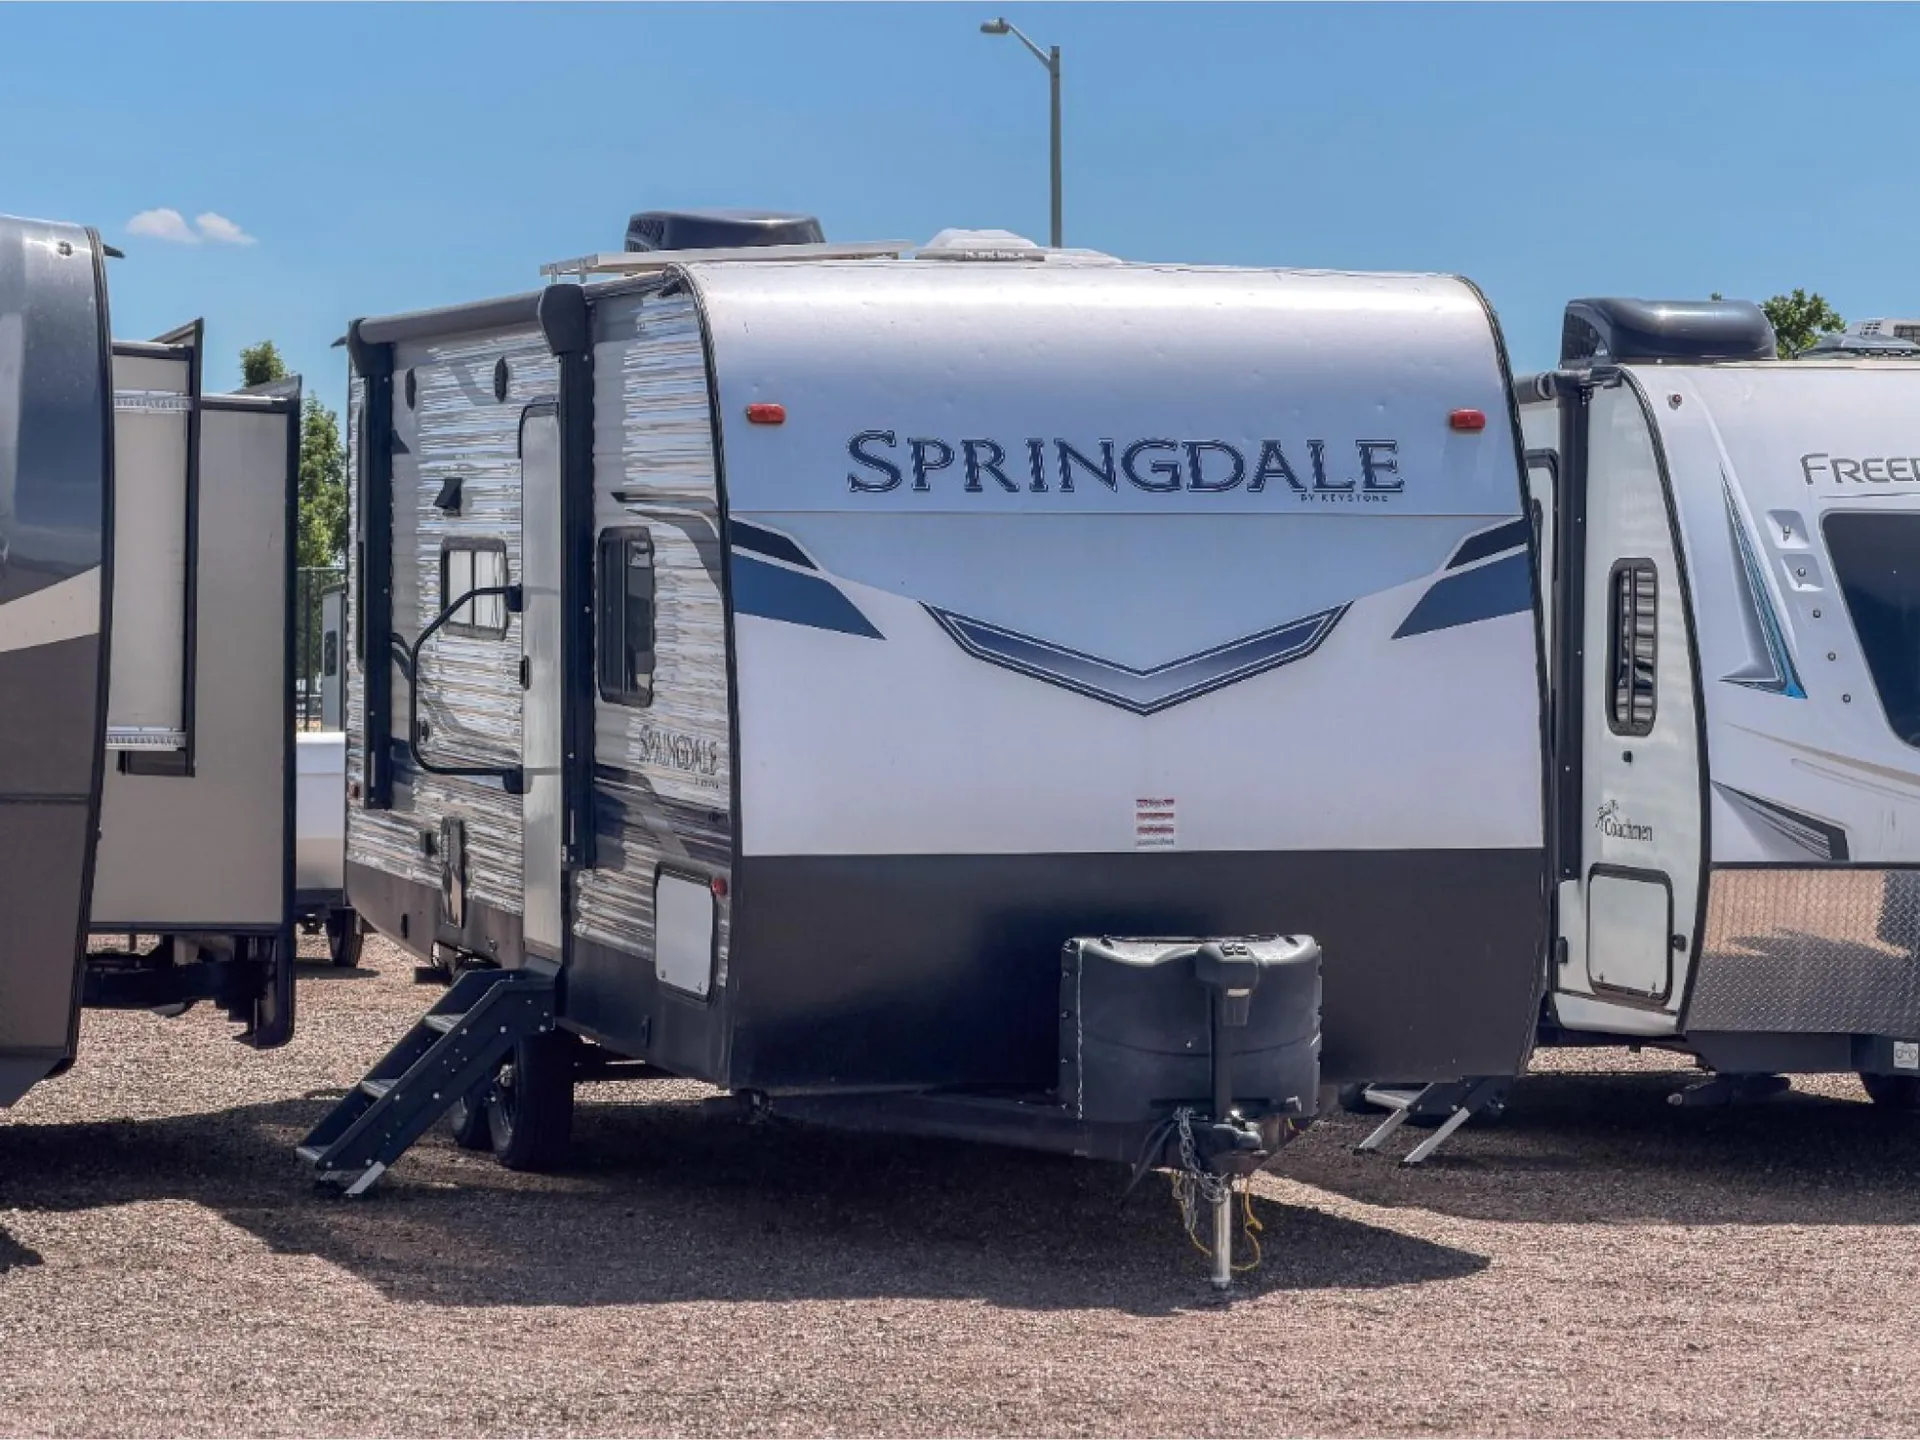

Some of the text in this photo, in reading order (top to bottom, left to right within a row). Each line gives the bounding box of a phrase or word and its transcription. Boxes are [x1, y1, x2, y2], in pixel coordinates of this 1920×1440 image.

[847, 430, 1405, 493] SPRINGDALE
[1300, 493, 1389, 502] BY KEYSTONE
